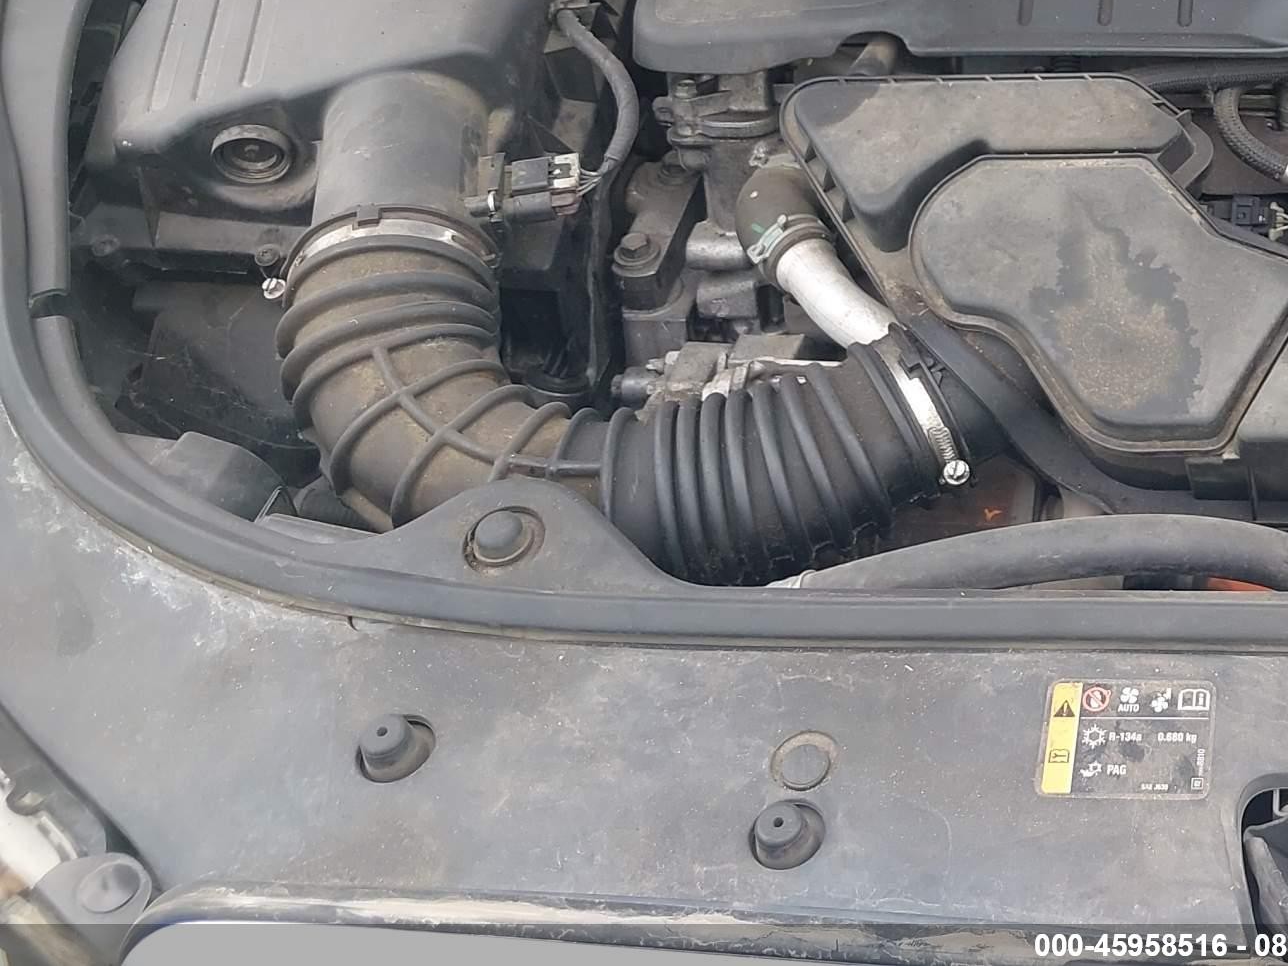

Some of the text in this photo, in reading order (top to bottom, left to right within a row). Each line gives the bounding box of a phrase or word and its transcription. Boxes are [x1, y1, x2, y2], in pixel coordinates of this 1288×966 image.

[1117, 703, 1140, 713] AUTO
[1108, 731, 1142, 742] R-134a
[1185, 732, 1198, 744] kg
[1106, 764, 1127, 775] PAG
